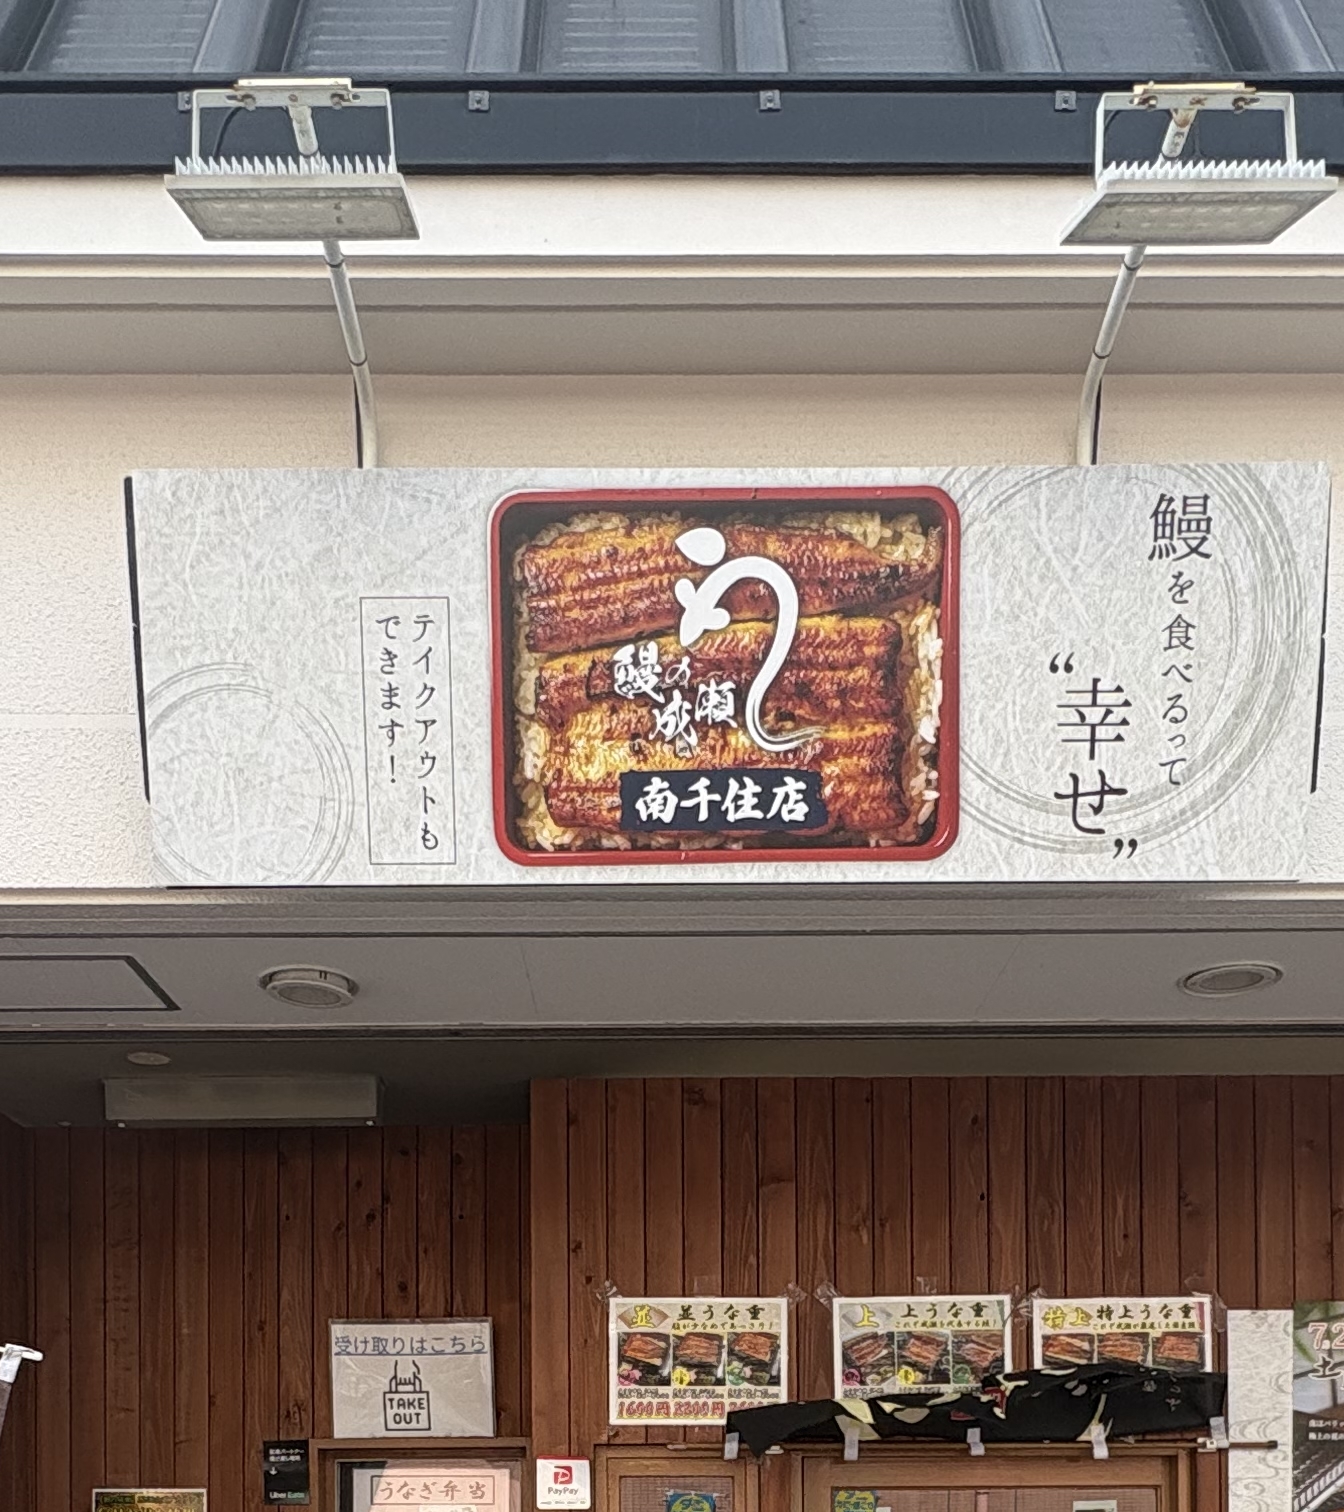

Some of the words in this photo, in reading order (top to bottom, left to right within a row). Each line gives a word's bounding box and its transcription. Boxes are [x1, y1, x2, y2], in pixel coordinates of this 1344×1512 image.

[1148, 493, 1214, 787] 鰻を食べるって
[374, 614, 404, 785] できます！
[613, 641, 738, 749] 鰻の成瀬
[412, 613, 440, 852] テイクアウトも
[635, 776, 810, 823] 南千住店
[677, 1304, 765, 1321] 並うな重
[856, 1303, 879, 1328] 上
[901, 1302, 989, 1319] 上うな重
[1042, 1305, 1093, 1330] 特上
[1097, 1303, 1195, 1321] 特上うな重
[335, 1335, 486, 1354] 受け取りはこちら
[388, 1397, 426, 1410] TAKE
[393, 1412, 422, 1424] OUT
[380, 1480, 487, 1500] うなぎ弁当
[548, 1487, 579, 1496] PayPay
